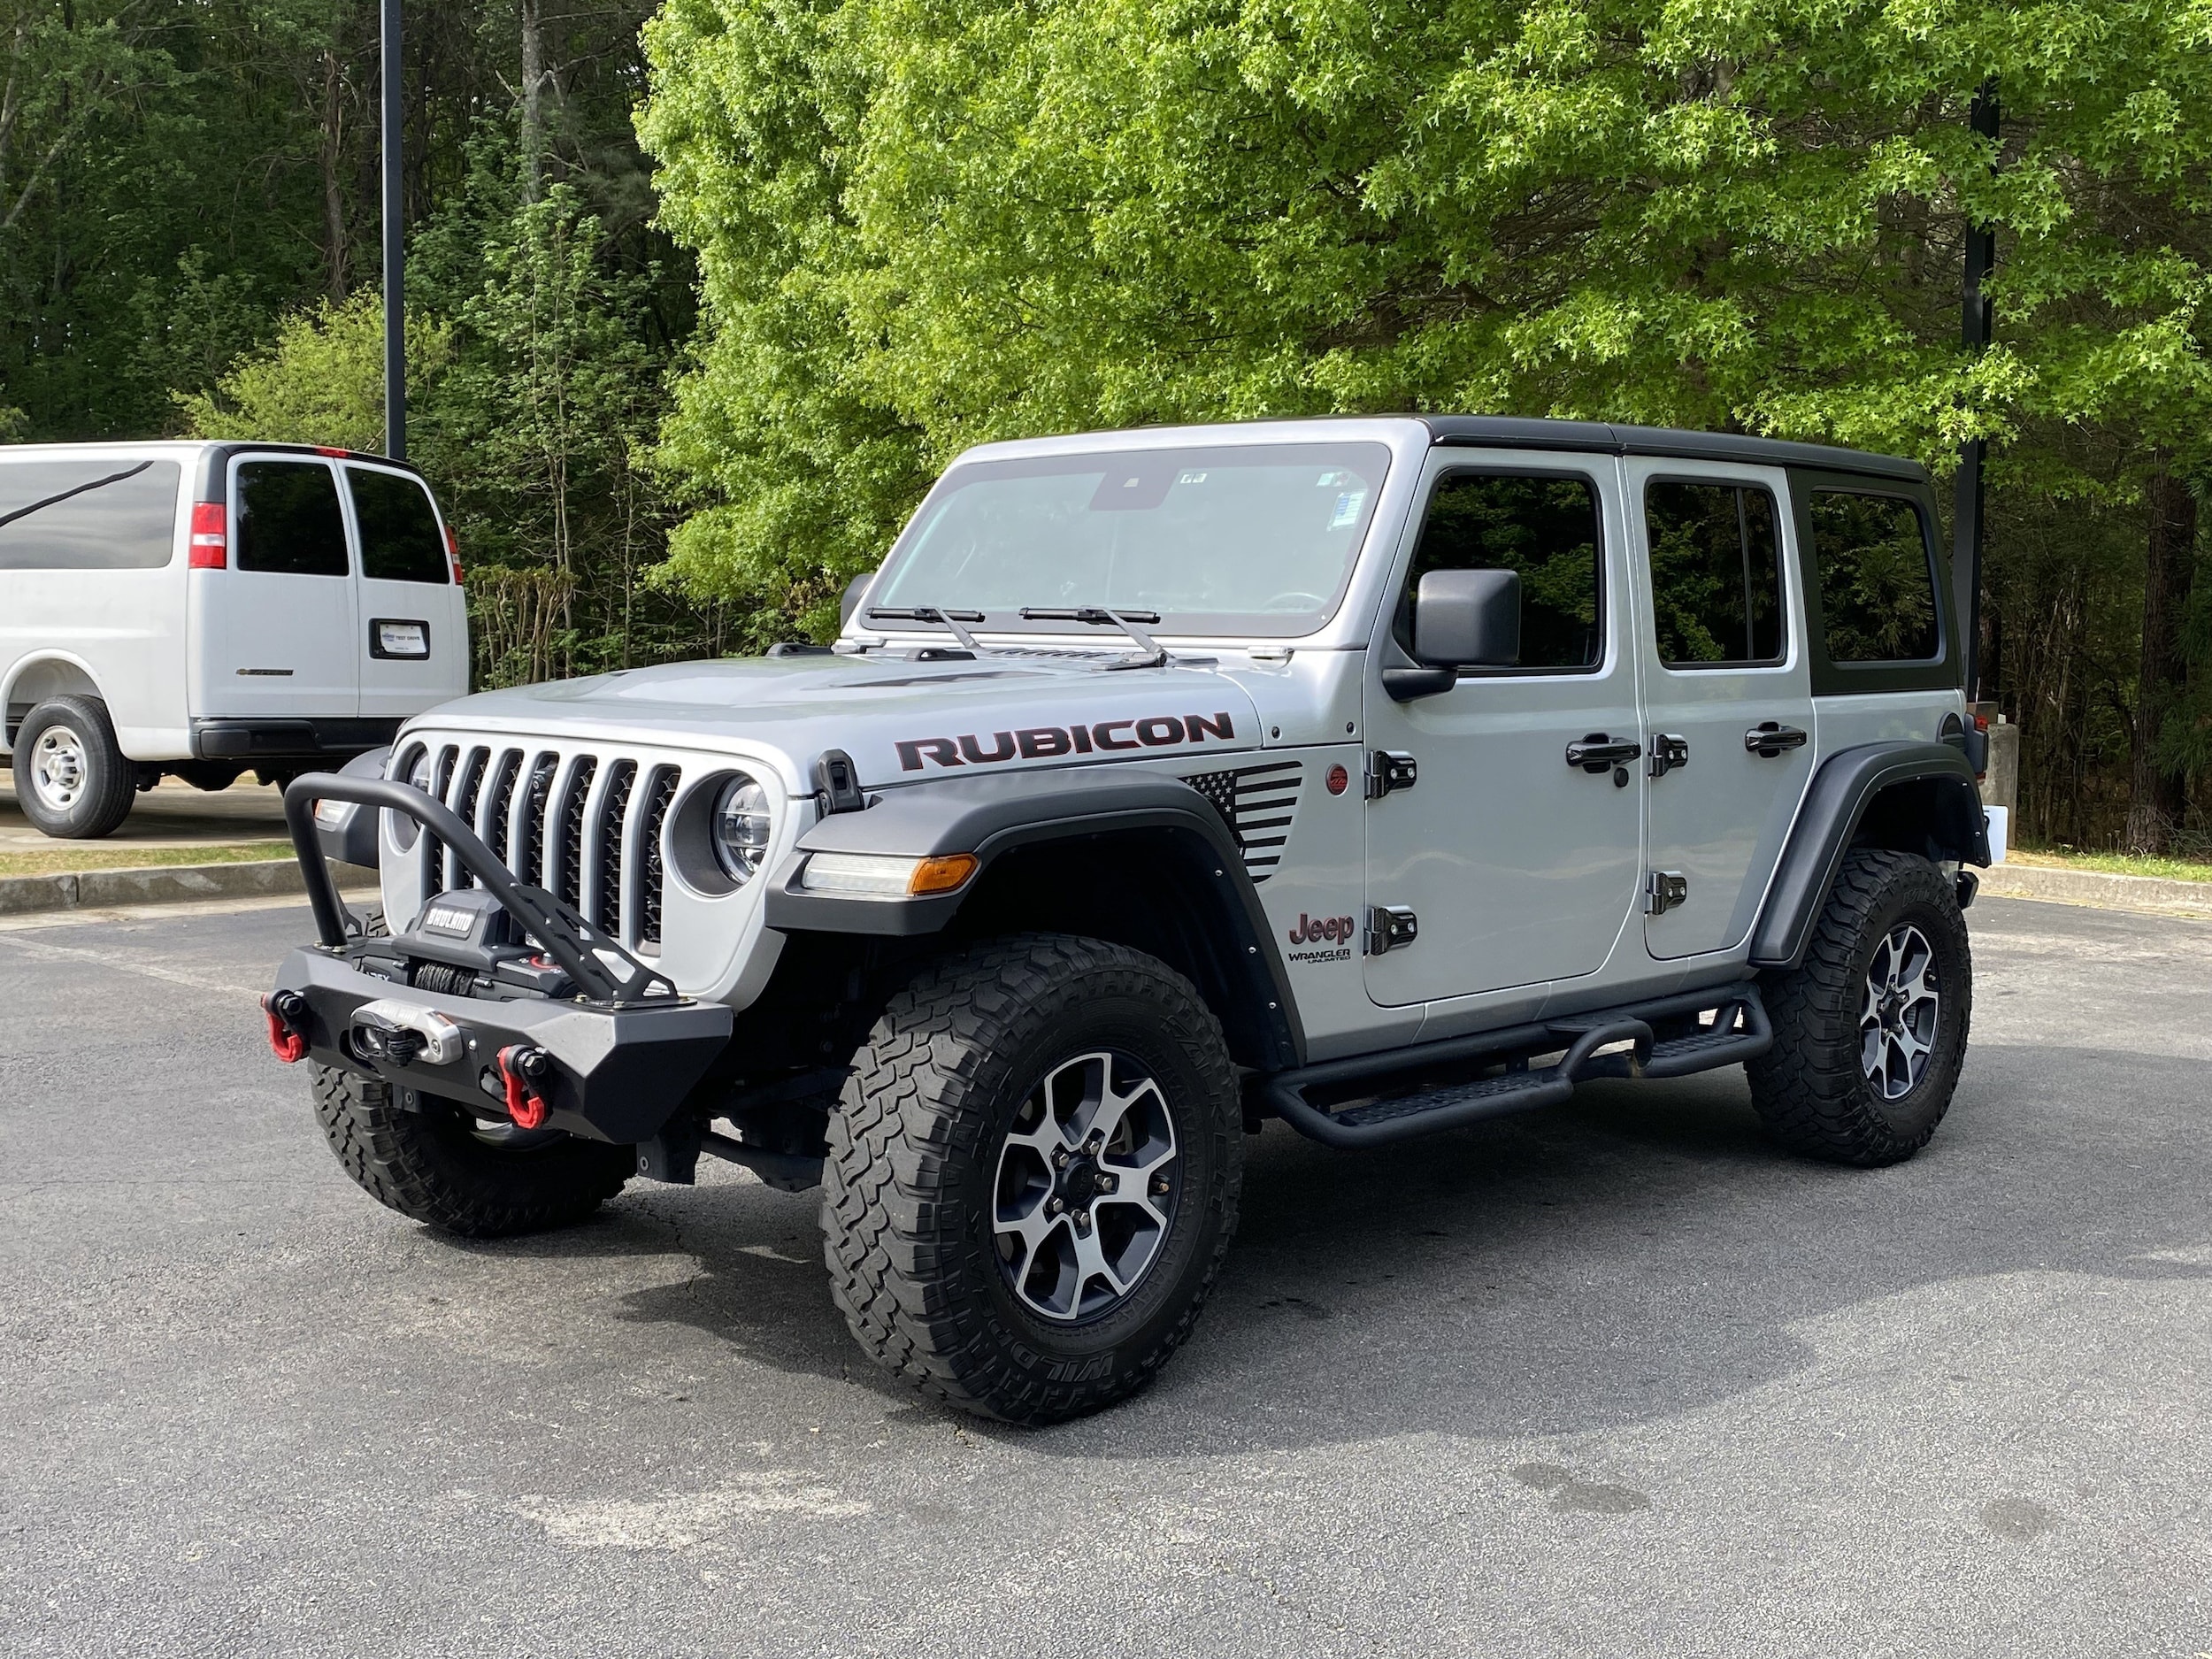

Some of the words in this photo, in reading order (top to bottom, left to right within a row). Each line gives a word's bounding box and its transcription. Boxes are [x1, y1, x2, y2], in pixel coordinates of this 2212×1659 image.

[894, 711, 1235, 772] RUBICON
[426, 908, 475, 932] BADLAND
[1289, 912, 1355, 945] Jeep
[1288, 948, 1351, 962] WRANGLER
